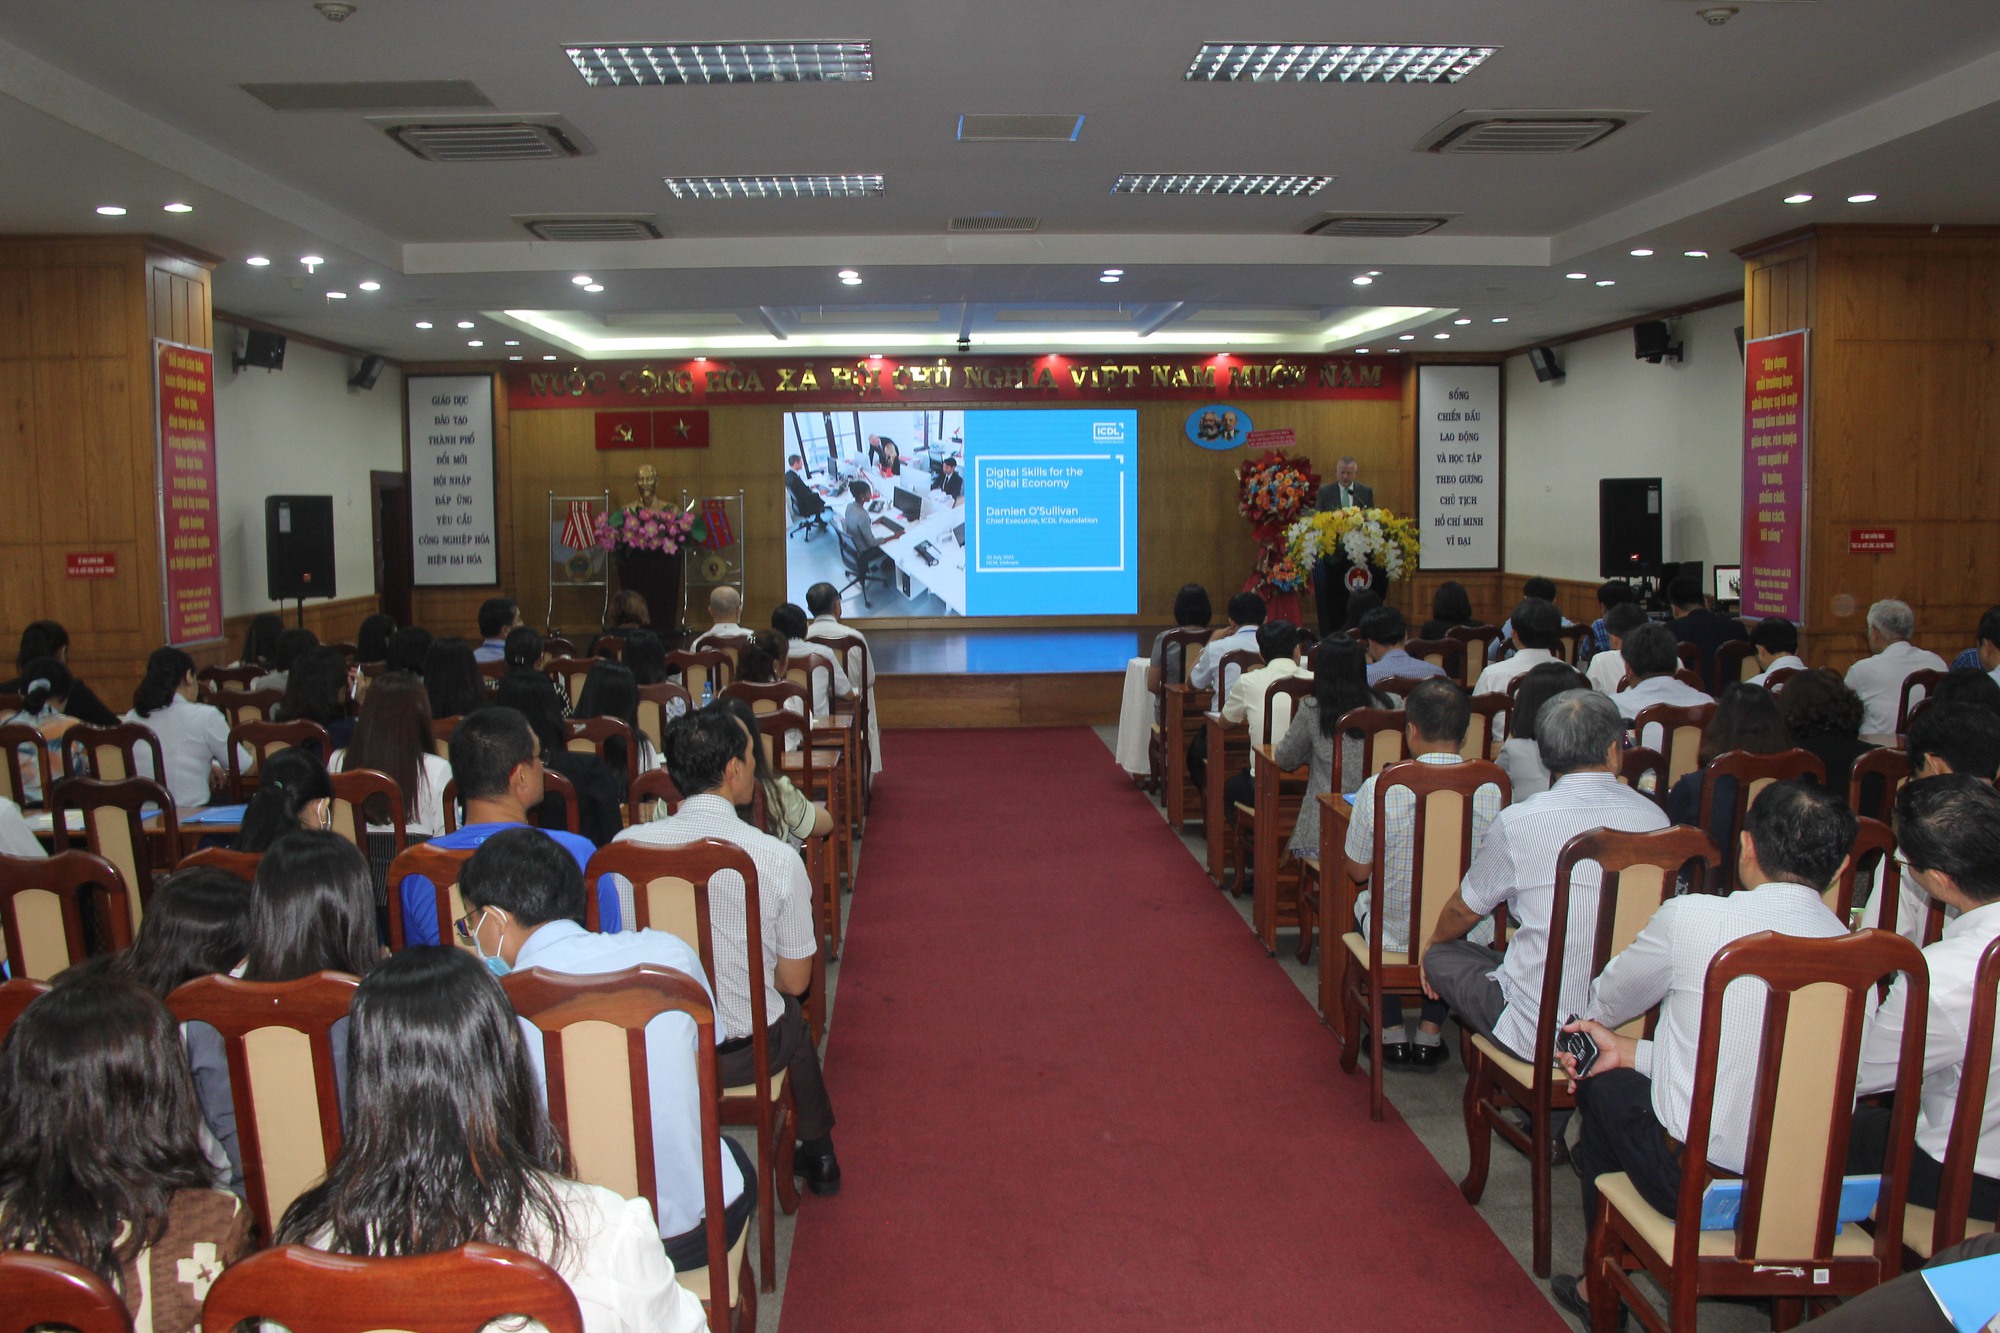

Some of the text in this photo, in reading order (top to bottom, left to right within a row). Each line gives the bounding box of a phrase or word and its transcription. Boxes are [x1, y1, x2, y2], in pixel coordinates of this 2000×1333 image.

[529, 357, 1383, 398] NƯỚC CỘNG HÒA XÃ HỘI CHỦ NGHĨA VIỆT NAM MUÔN NĂM
[1448, 386, 1470, 400] SỐNG
[1437, 408, 1480, 422] CHIẾN ĐẤU
[1097, 427, 1120, 436] ICDL
[1440, 430, 1479, 444] LAO ĐỘNG
[1436, 451, 1482, 465] VÀ HỌC TẬP
[986, 466, 1084, 478] Digital Skills for the
[1436, 473, 1484, 484] THEO GƯƠNG
[986, 479, 1070, 490] Digital Economy
[1440, 492, 1477, 507] CHỦ TỊCH
[986, 506, 1026, 516] Damien
[1434, 512, 1484, 526] HỒ CHÍ MINH
[1446, 534, 1471, 547] VĨ ĐẠI
